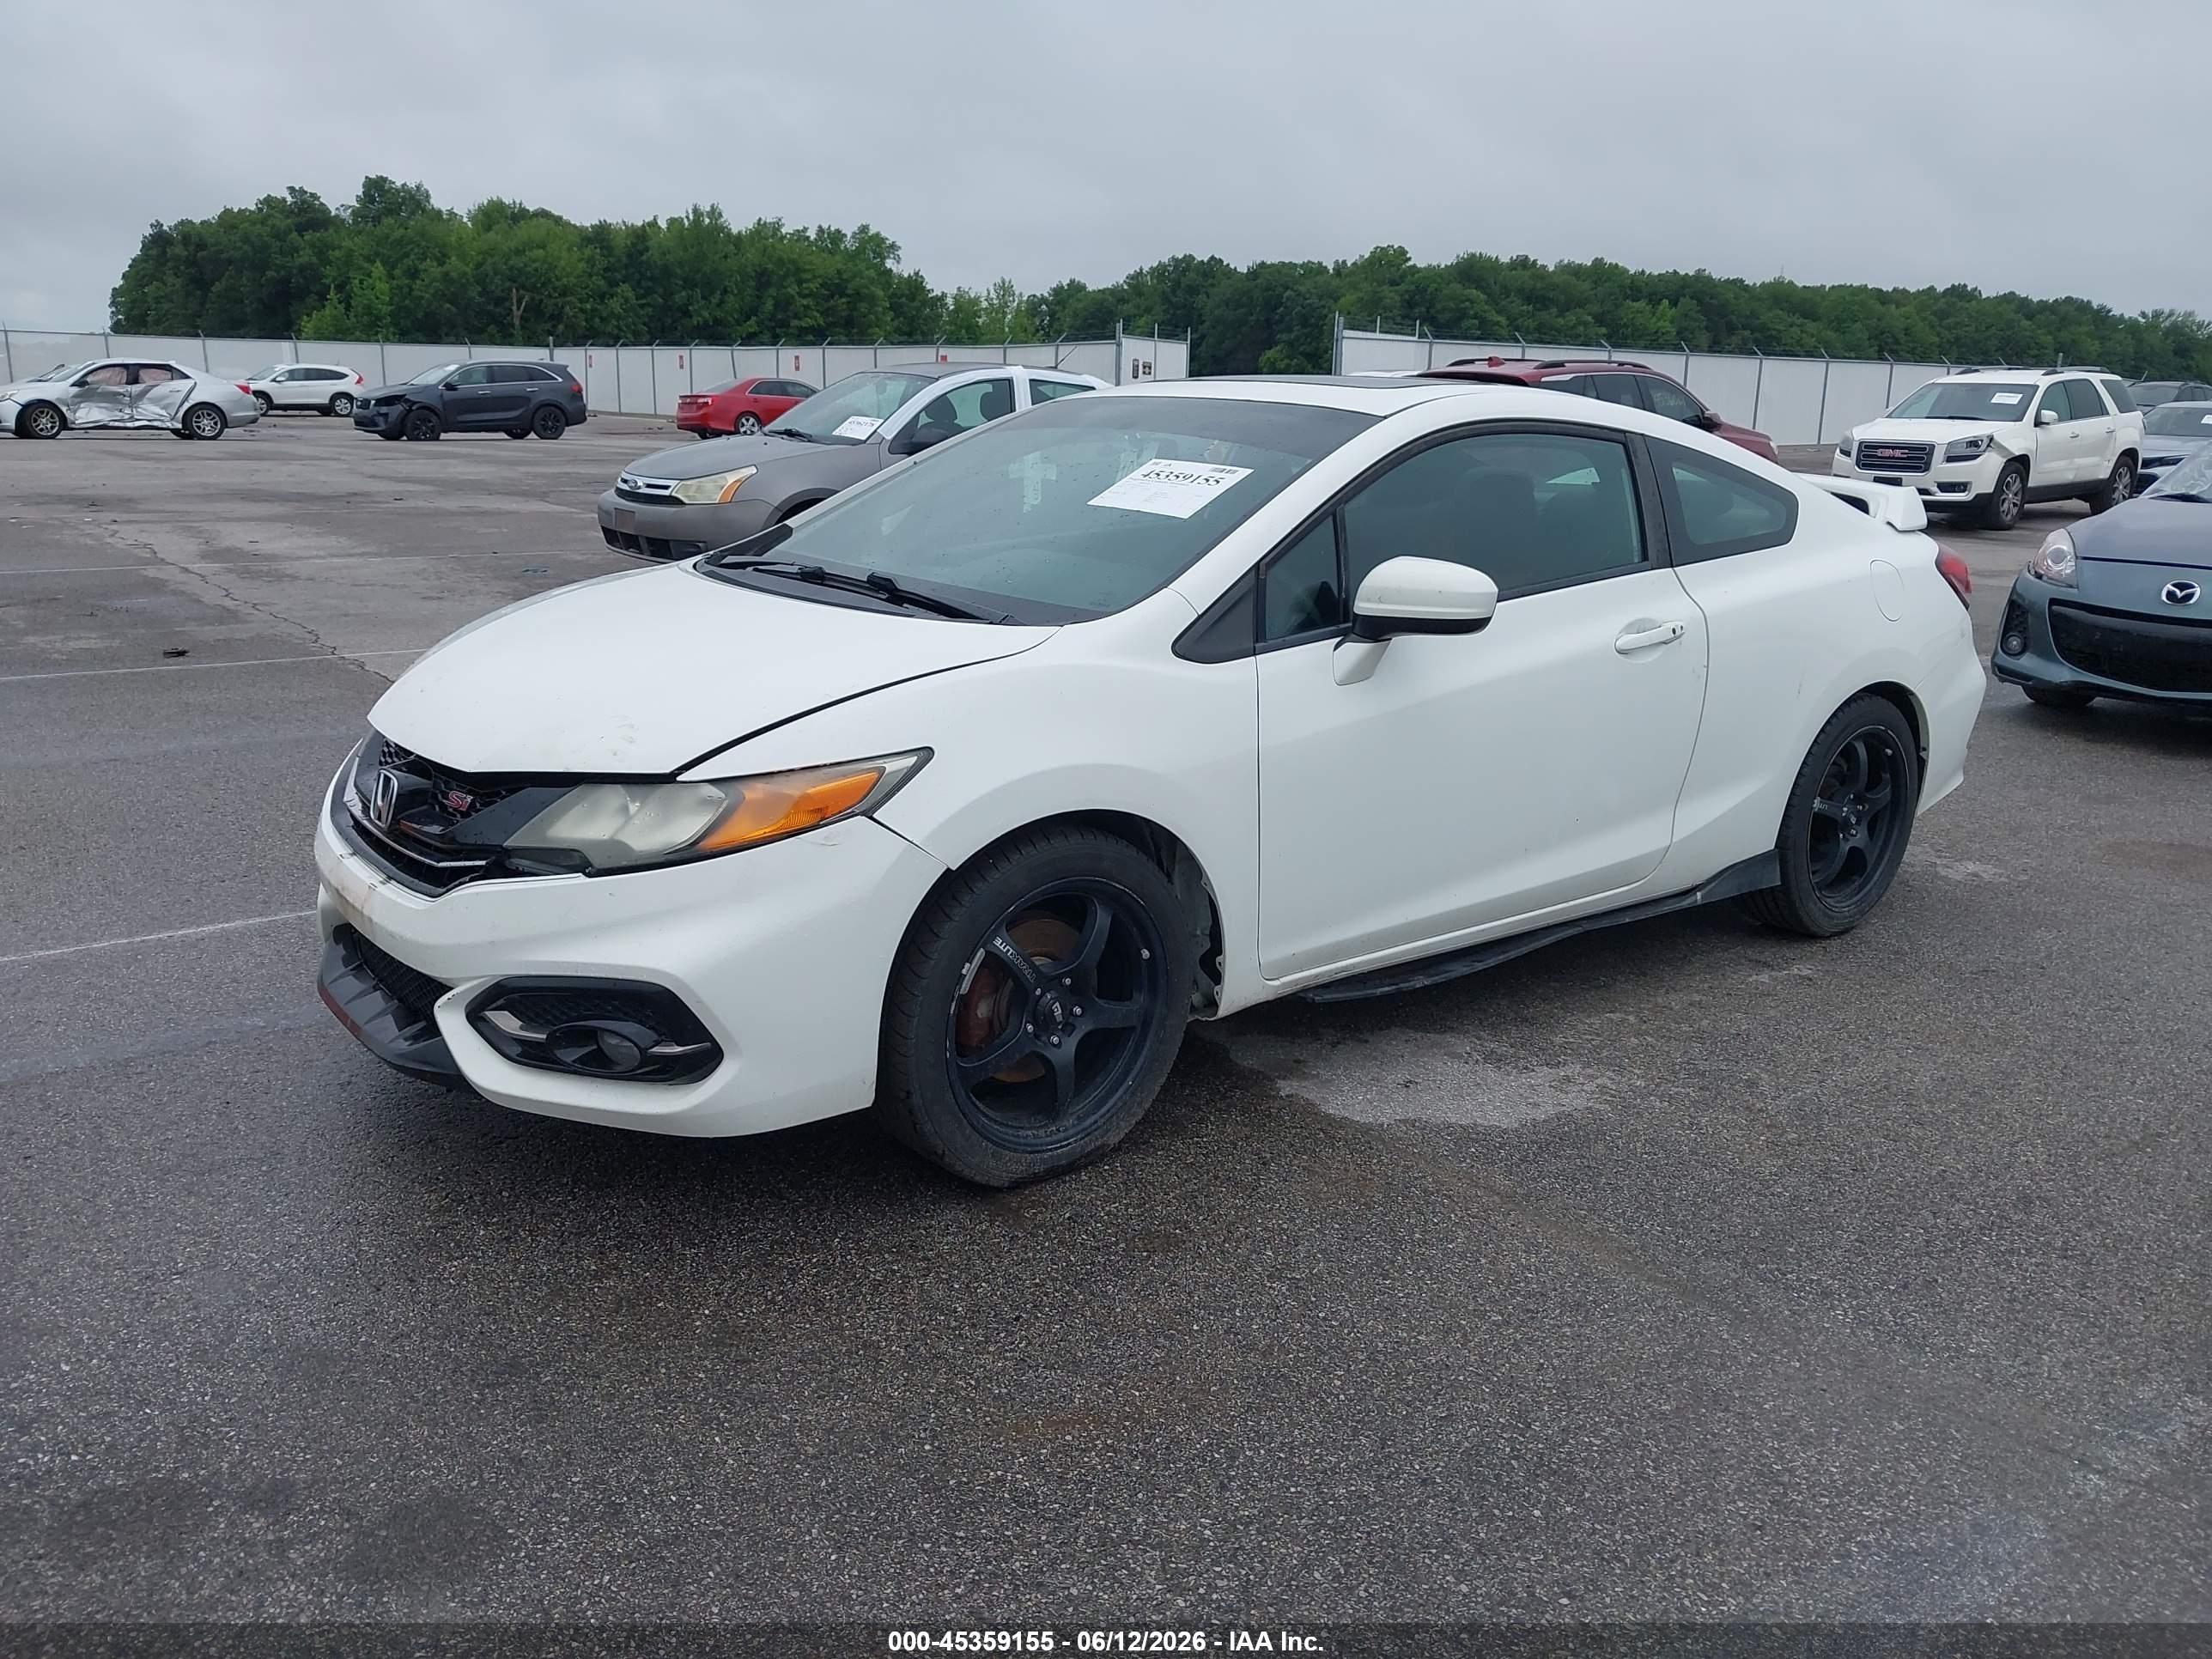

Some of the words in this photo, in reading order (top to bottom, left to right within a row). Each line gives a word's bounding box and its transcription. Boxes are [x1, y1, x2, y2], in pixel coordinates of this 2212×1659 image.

[1877, 448, 1909, 458] GMC
[1141, 470, 1225, 486] 45359155
[442, 790, 474, 811] Si
[993, 935, 1037, 983] TRAKLITE
